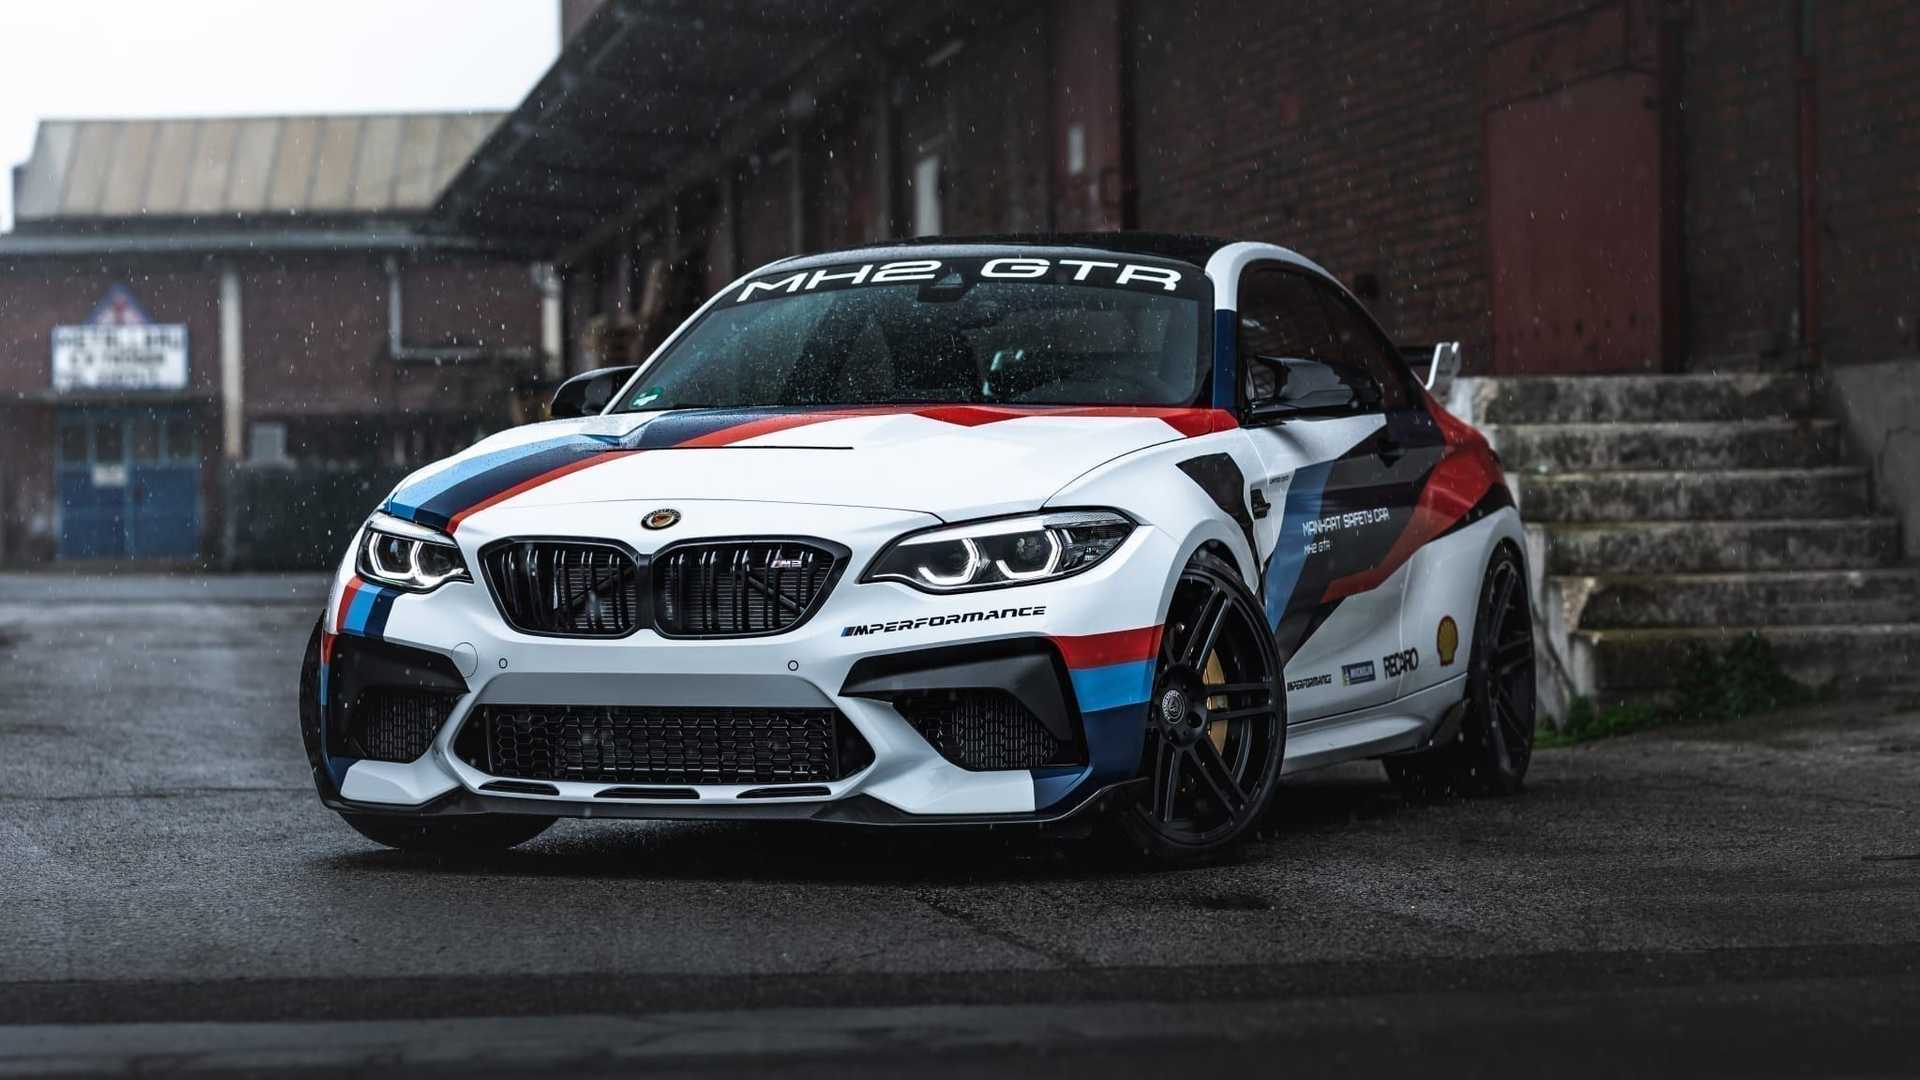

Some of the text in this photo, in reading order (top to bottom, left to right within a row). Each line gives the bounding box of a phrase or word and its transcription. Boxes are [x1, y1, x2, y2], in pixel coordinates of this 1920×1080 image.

[737, 258, 1182, 302] MH2 GTR
[1302, 506, 1391, 537] MANHART SAFETY CAR
[1382, 647, 1419, 680] RECARO
